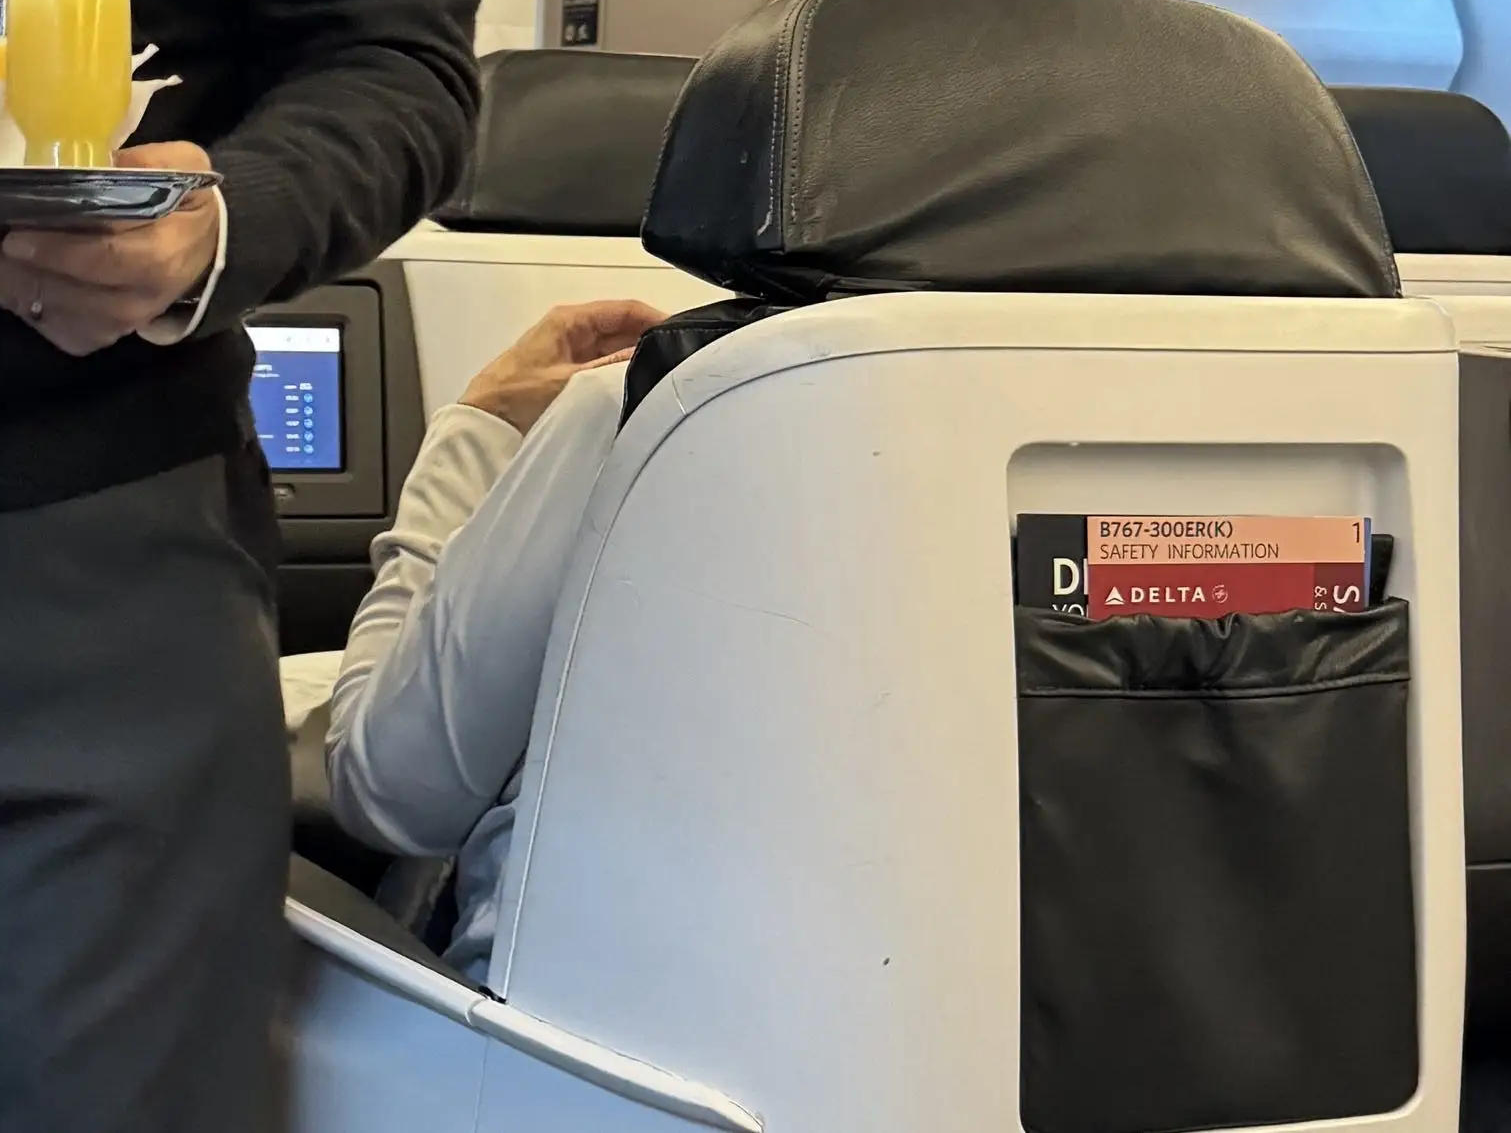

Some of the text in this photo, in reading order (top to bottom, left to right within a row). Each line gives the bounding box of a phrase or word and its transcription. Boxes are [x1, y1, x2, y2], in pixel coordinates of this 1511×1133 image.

[1100, 520, 1233, 539] B767-300ER(K)
[1352, 522, 1360, 543] 1
[1100, 543, 1279, 560] SAFETY INFORMATION
[1130, 586, 1206, 603] DELTA
